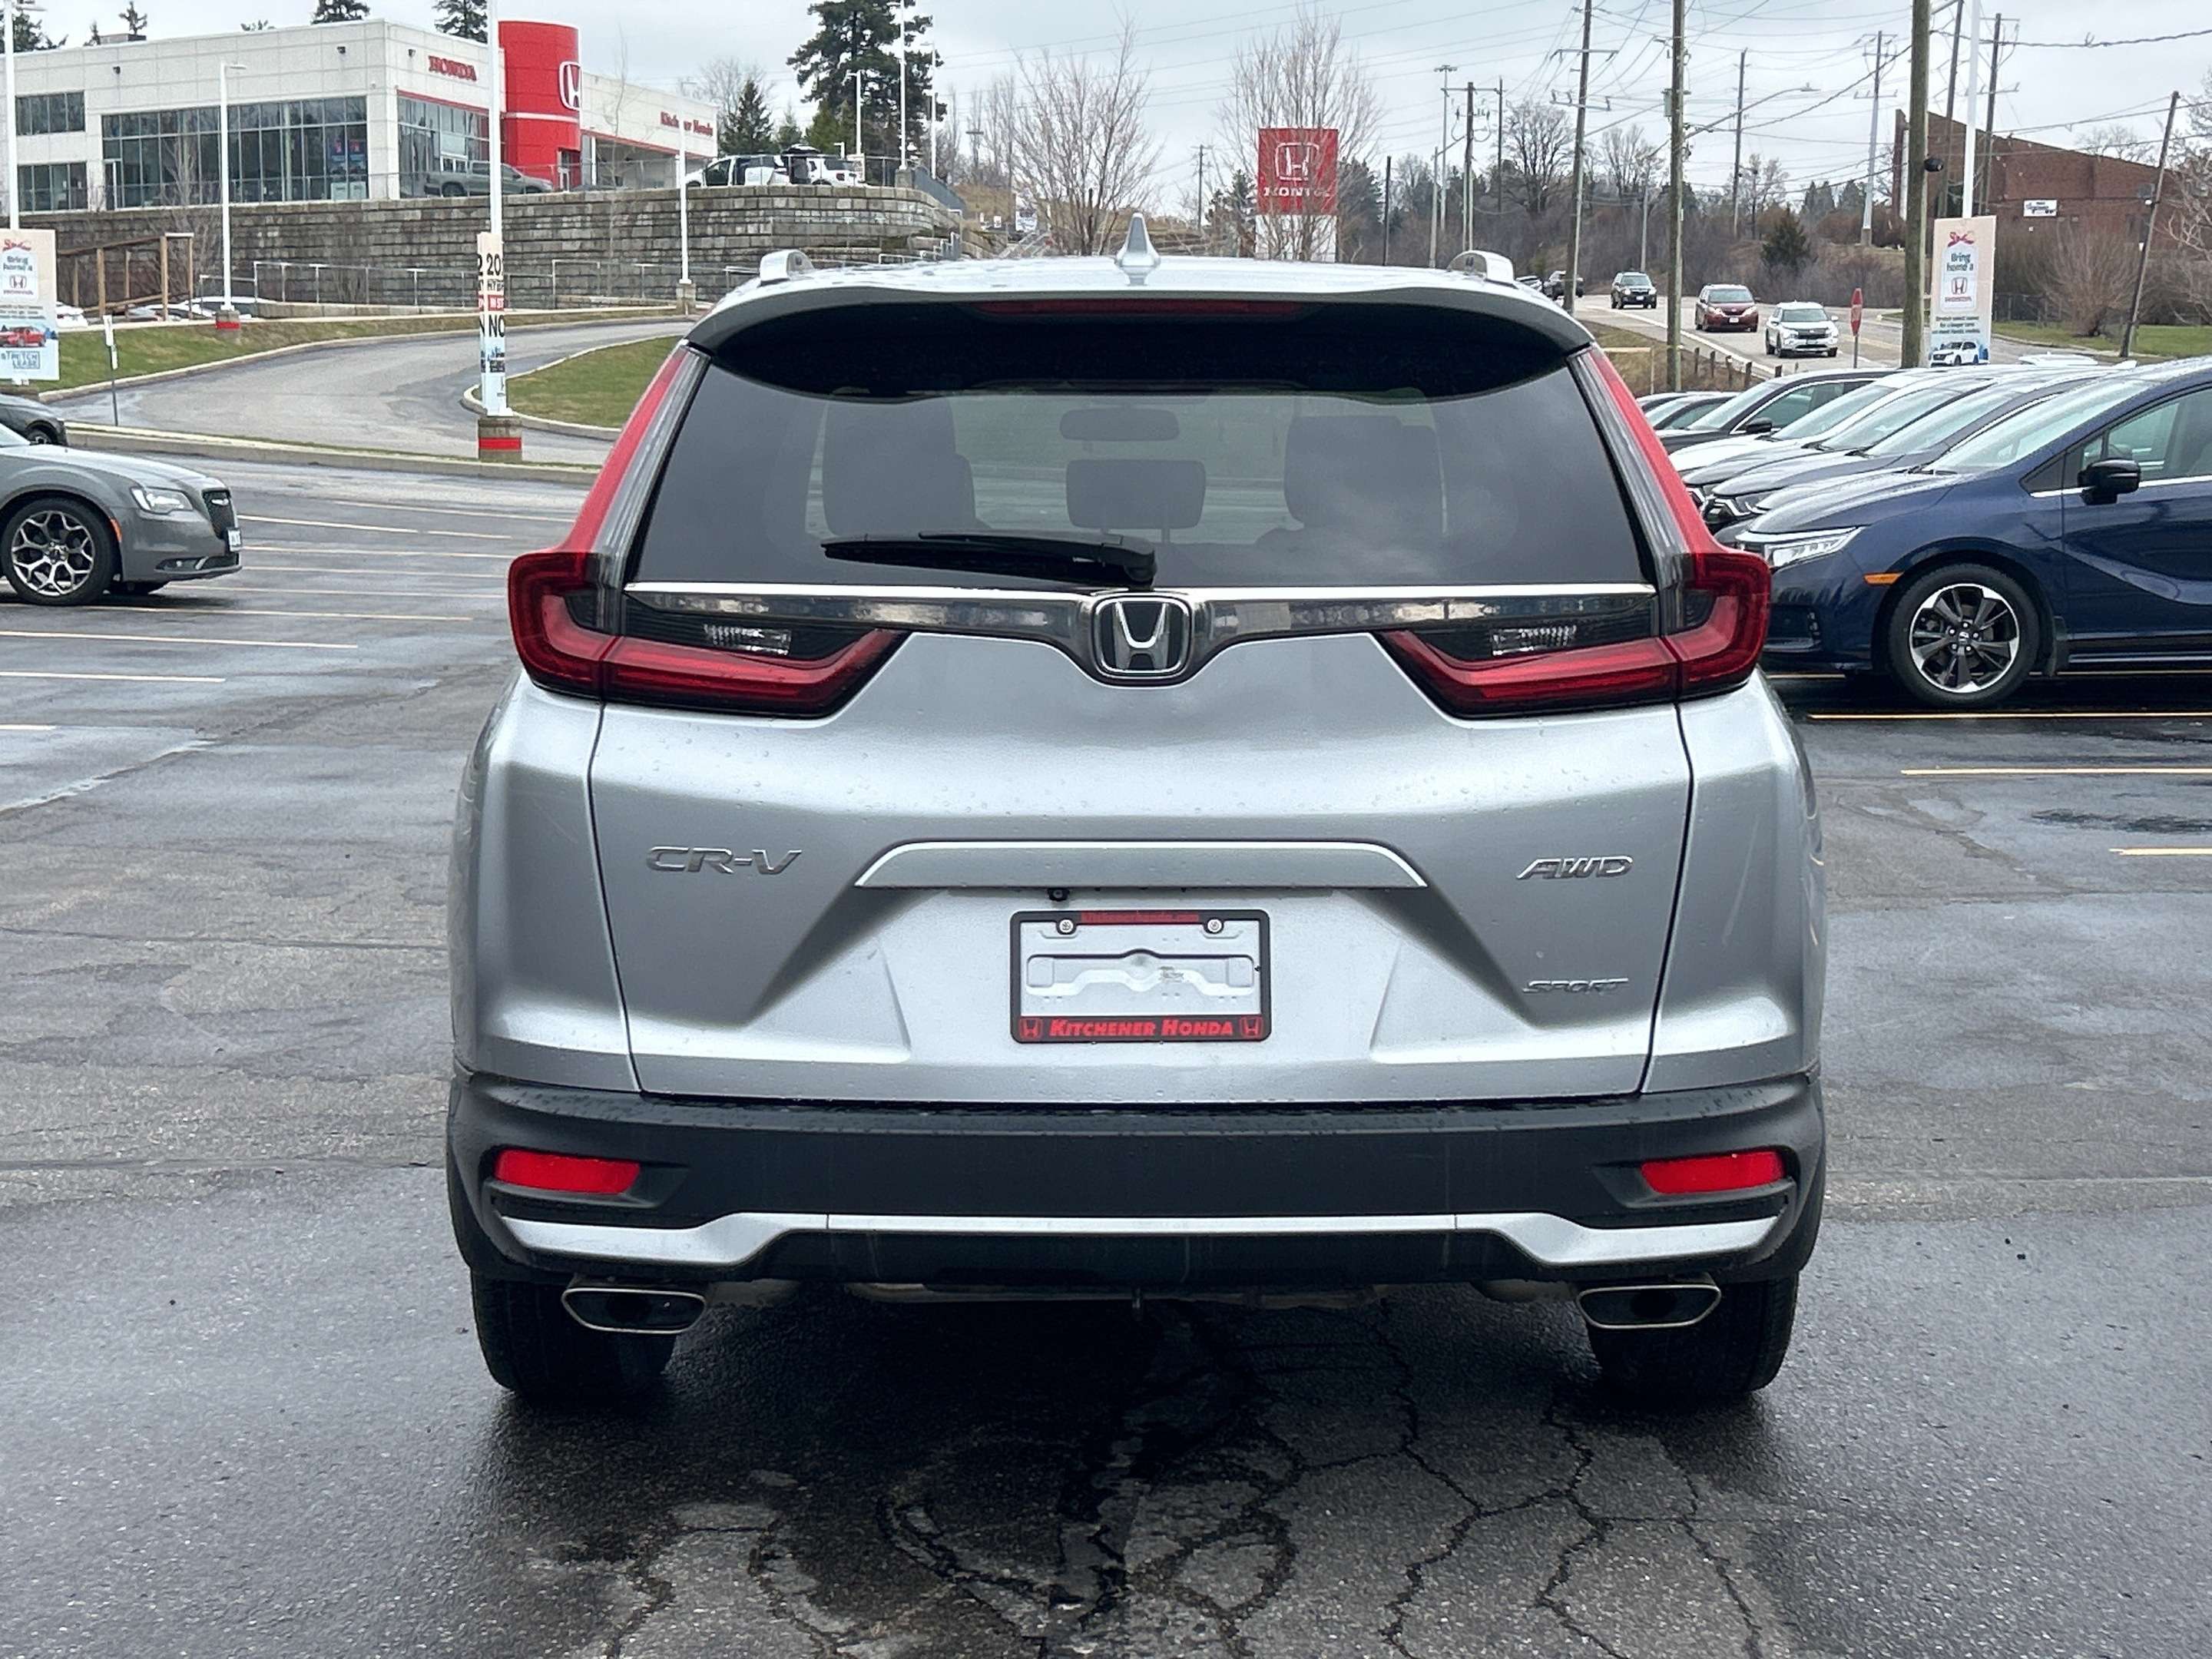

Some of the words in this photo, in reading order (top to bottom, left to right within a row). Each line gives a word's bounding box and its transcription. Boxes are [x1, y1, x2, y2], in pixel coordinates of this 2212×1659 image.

[429, 55, 477, 81] HONDA
[661, 111, 691, 131] Kitcher
[1946, 263, 1968, 271] home
[1951, 253, 1971, 263] Bring
[646, 845, 803, 875] CR-V
[1516, 856, 1634, 880] AWD
[1522, 977, 1629, 997] SPORT
[1048, 1018, 1156, 1037] KITCHENER
[1161, 1018, 1233, 1037] HONDA
